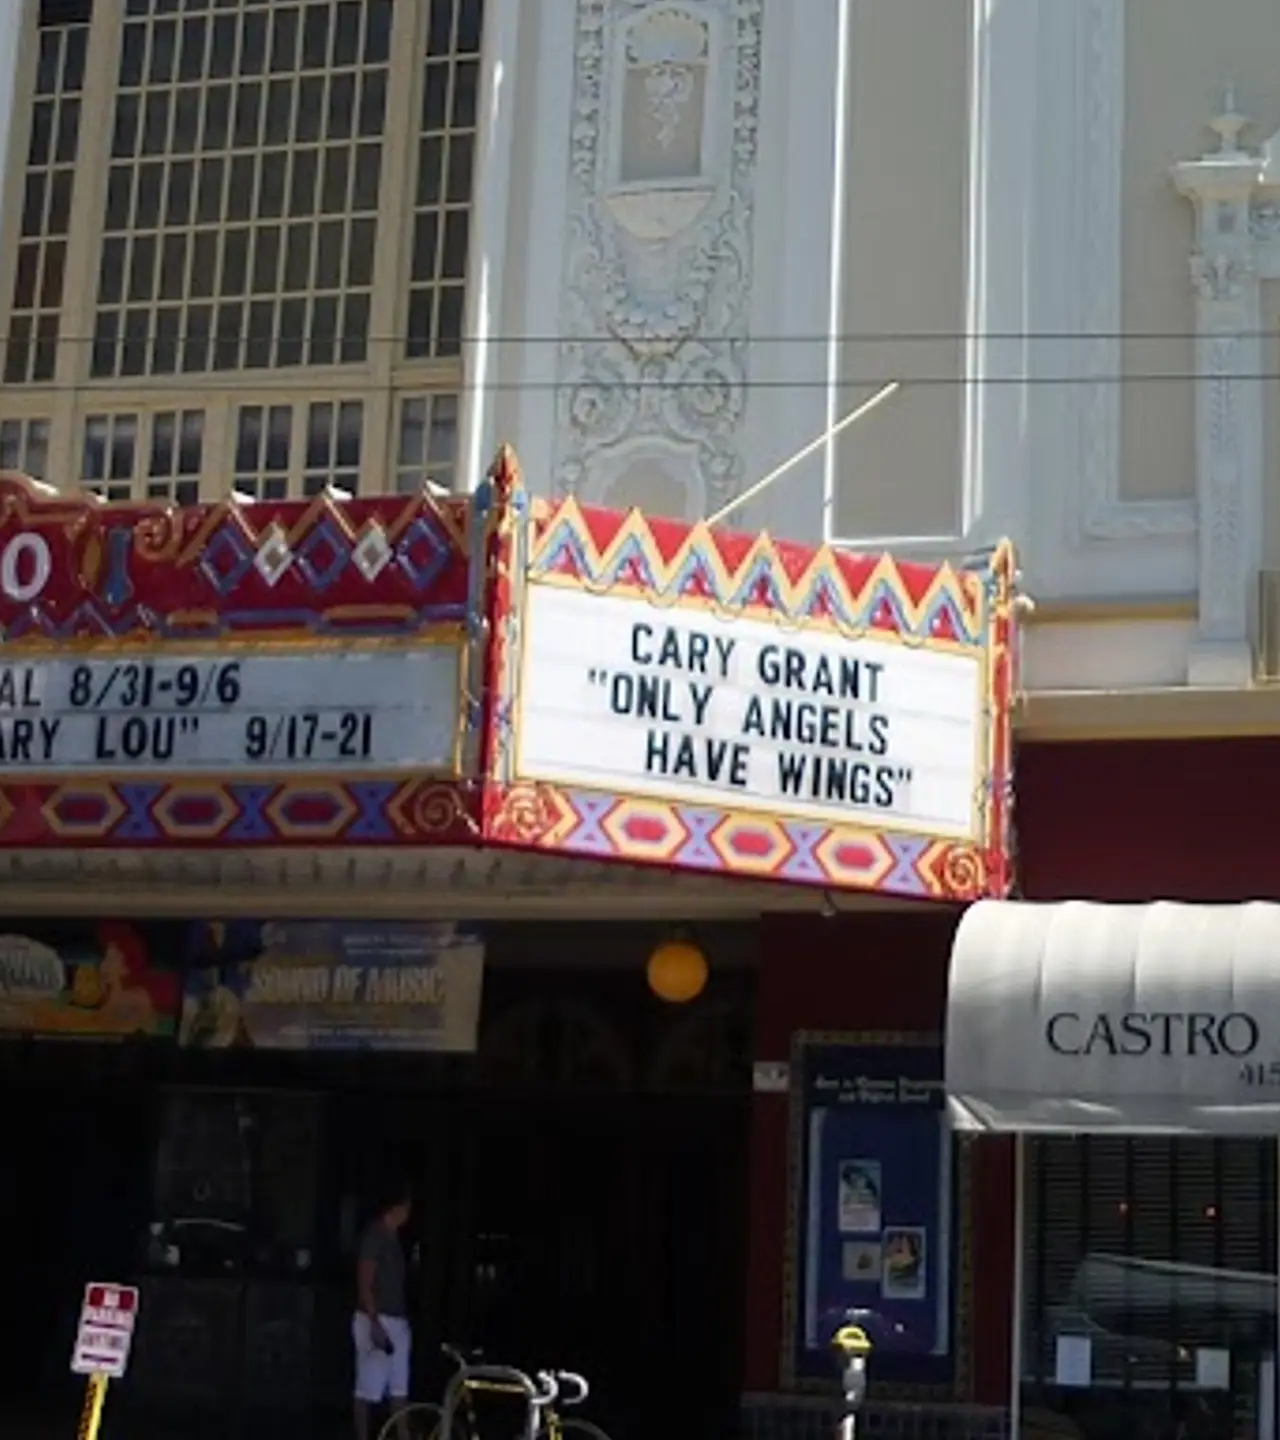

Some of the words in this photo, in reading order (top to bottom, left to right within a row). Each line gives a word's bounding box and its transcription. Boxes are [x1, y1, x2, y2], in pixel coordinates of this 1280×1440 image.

[69, 661, 241, 708] 8/31-9/6
[631, 622, 736, 678] CARY
[758, 643, 885, 703] GRANT
[96, 716, 200, 760] LOU"
[245, 712, 373, 759] 9/17-21
[587, 668, 715, 727] "ONLY
[741, 695, 890, 756] ANGELS
[646, 730, 751, 787] HAVE
[777, 757, 913, 809] WINGS"
[333, 965, 361, 1004] OF
[365, 966, 447, 1004] MUSIC
[1047, 1012, 1258, 1057] CASTRO
